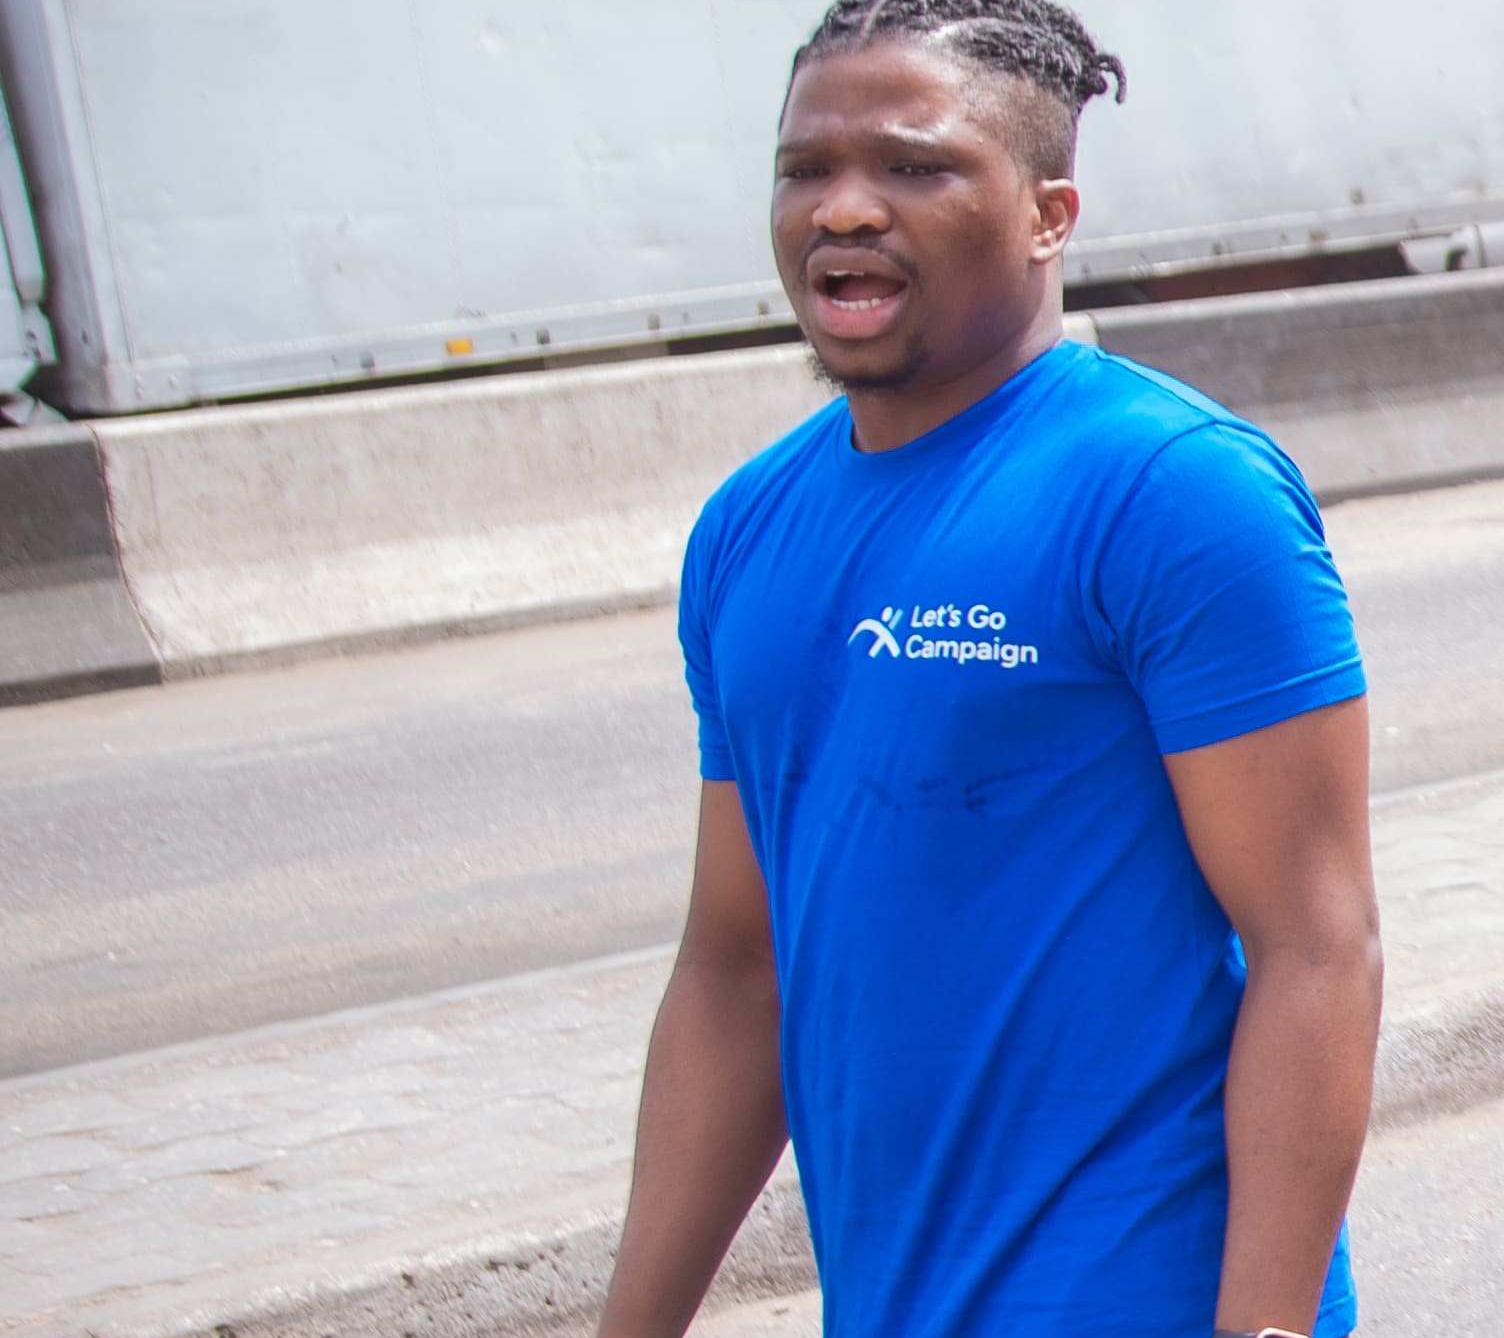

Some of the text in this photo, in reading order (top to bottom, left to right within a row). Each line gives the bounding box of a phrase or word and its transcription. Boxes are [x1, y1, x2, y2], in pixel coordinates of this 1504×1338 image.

[910, 604, 1006, 630] Let's Go
[905, 634, 1038, 668] Campaign
